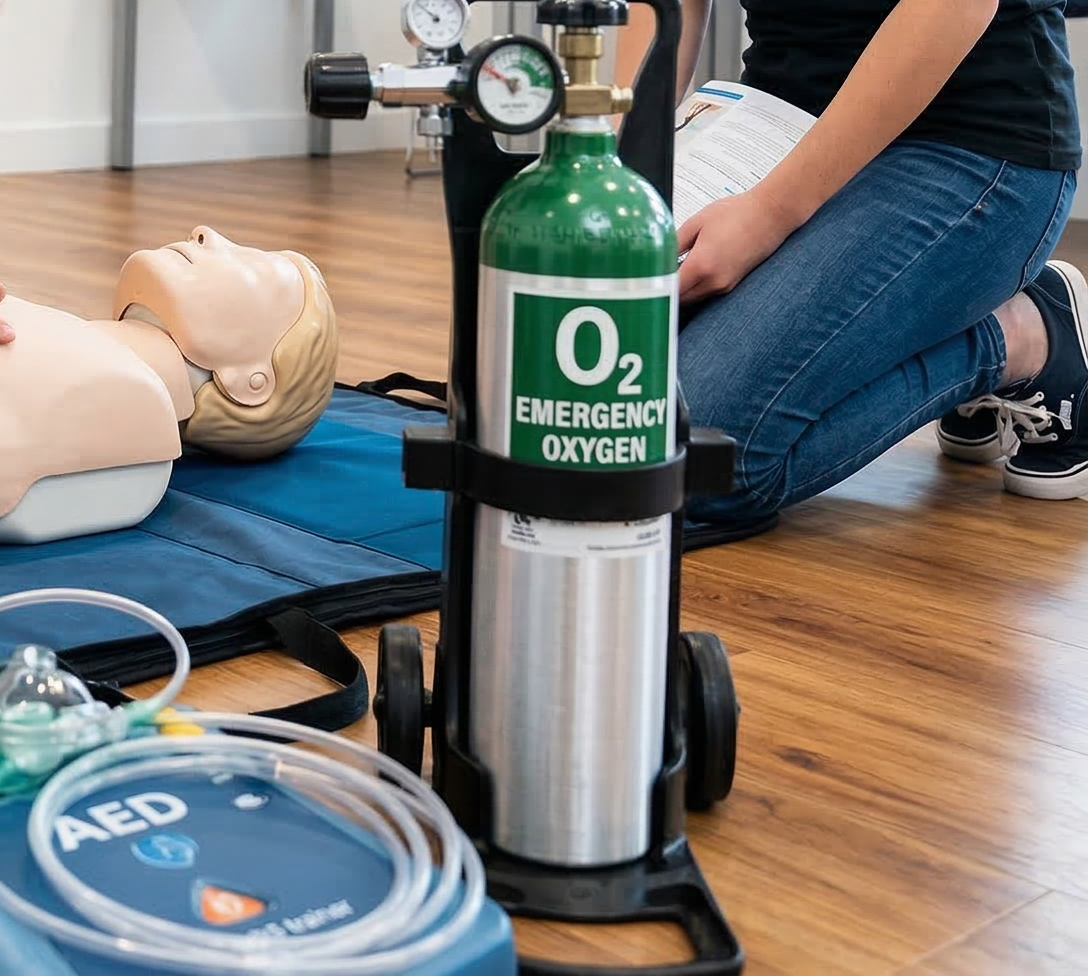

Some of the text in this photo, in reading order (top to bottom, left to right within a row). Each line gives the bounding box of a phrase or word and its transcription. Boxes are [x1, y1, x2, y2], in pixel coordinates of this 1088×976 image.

[515, 395, 667, 430] EMERGENCY
[541, 434, 647, 464] OXYGEN
[53, 791, 189, 853] AED
